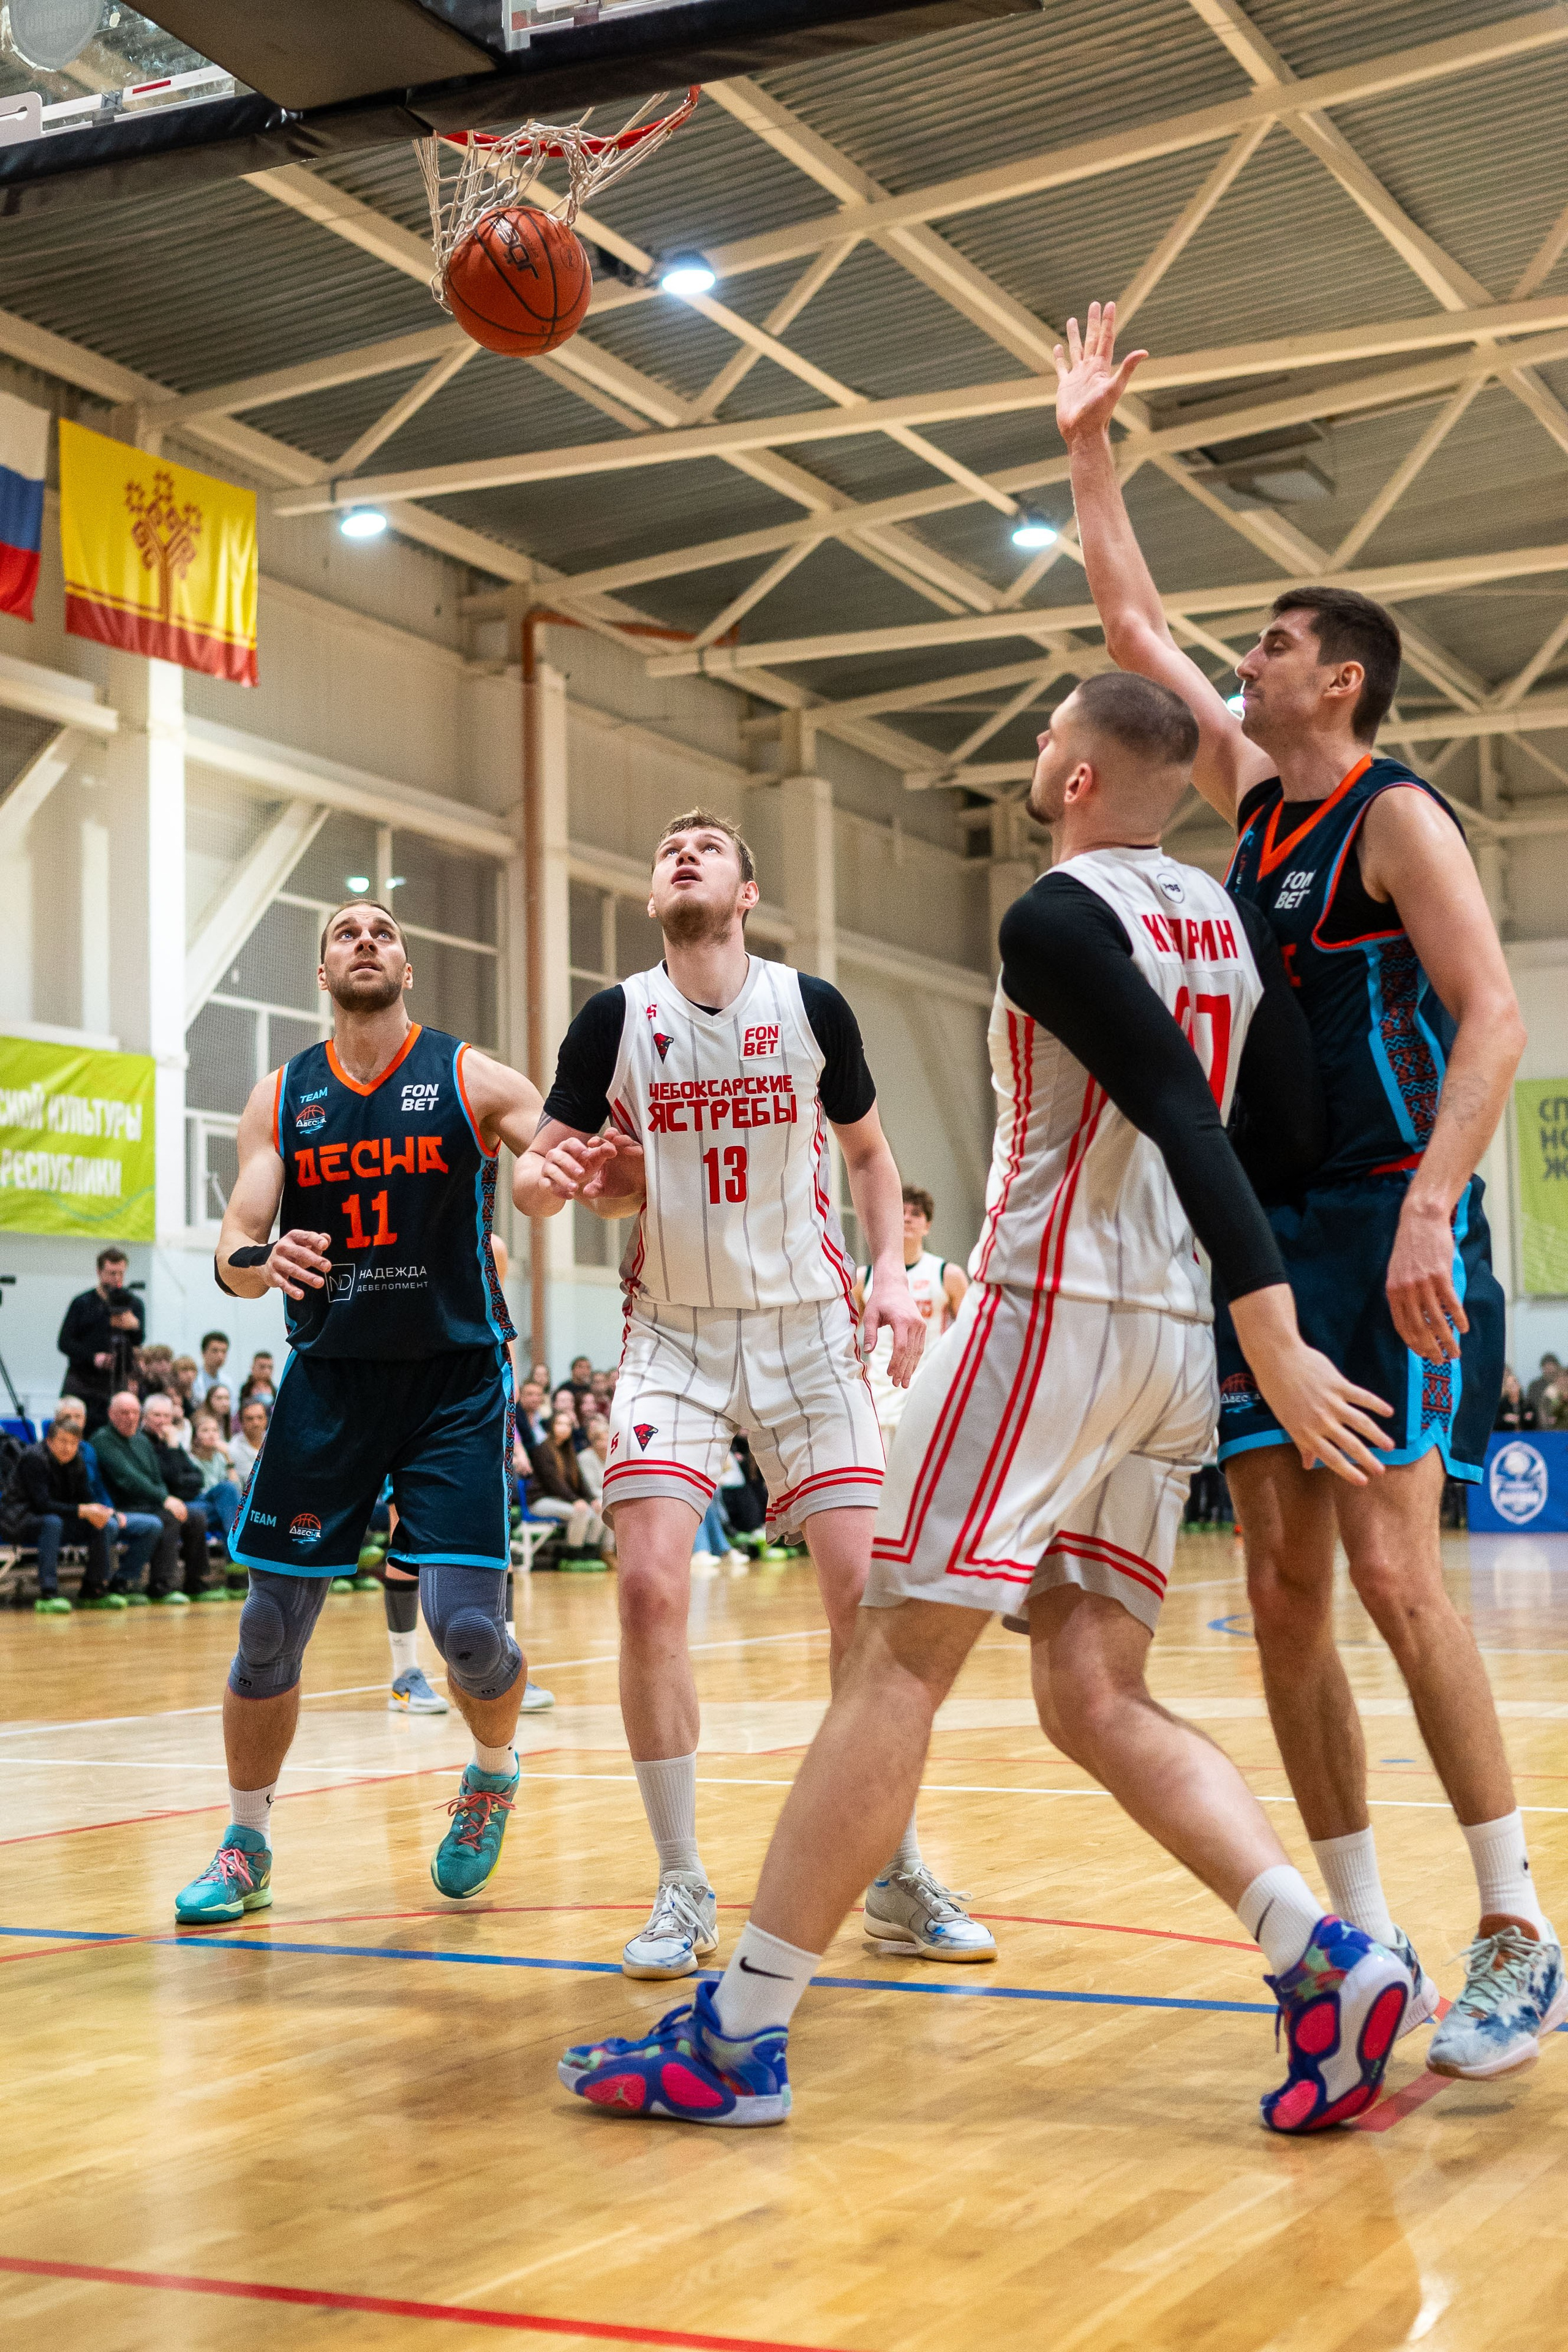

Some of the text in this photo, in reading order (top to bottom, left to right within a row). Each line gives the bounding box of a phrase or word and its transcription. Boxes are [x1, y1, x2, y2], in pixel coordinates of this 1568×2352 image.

[1282, 870, 1316, 889] FON
[1274, 890, 1311, 909] BET
[744, 1025, 779, 1042] FON
[743, 1040, 778, 1057] BET
[300, 1087, 328, 1104] TEAM
[401, 1084, 439, 1098] FON
[649, 1074, 794, 1101] ЧЕБОКСАРСКИЕ
[401, 1097, 439, 1112] BET
[647, 1094, 797, 1133] ЯСТРЕБЫ
[295, 1136, 448, 1188] ДЕСНА
[1, 1148, 122, 1197] РЕСПУБЛИКИ
[703, 1145, 747, 1205] 13
[342, 1190, 398, 1250] 11
[359, 1265, 428, 1280] НАДЕЖДА
[356, 1281, 429, 1292] ДЕВЕЛОПМЕНТ
[250, 1510, 277, 1528] TEAM
